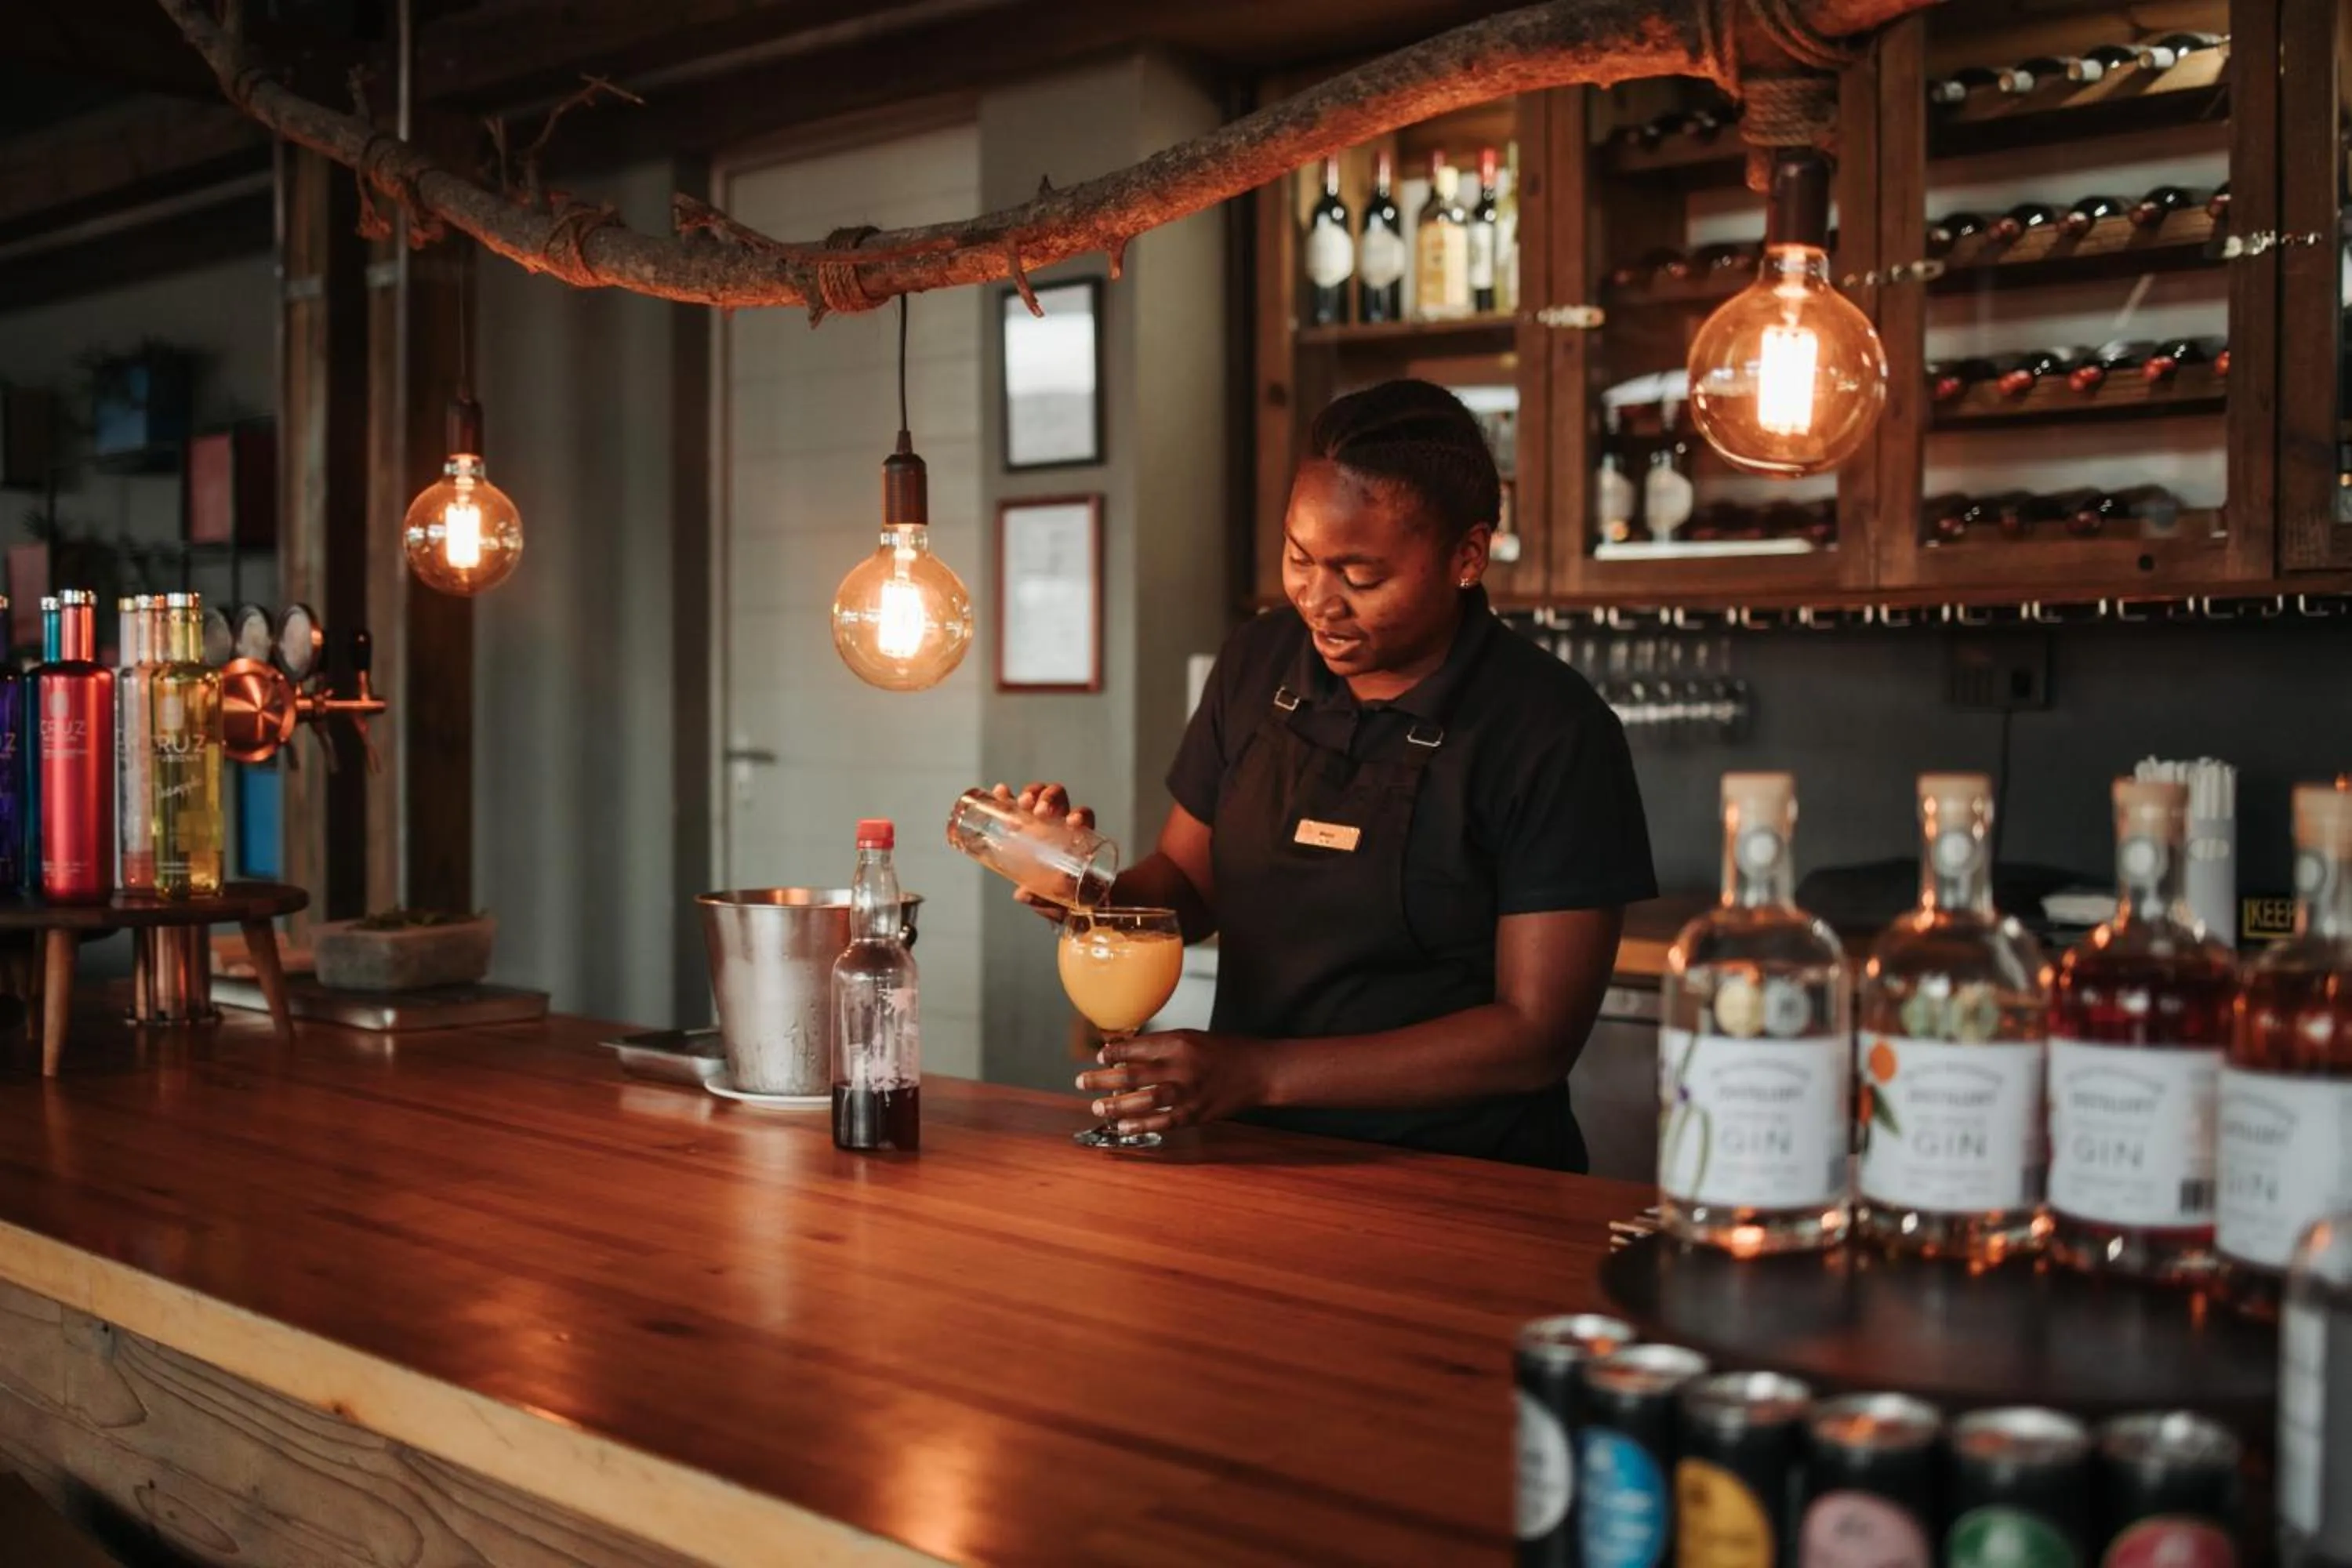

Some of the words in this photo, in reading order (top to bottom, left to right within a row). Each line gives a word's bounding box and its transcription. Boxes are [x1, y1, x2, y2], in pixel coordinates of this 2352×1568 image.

[1722, 1123, 1793, 1156] GIN
[1913, 1127, 1987, 1159] GIN
[2073, 1129, 2144, 1169] GIN
